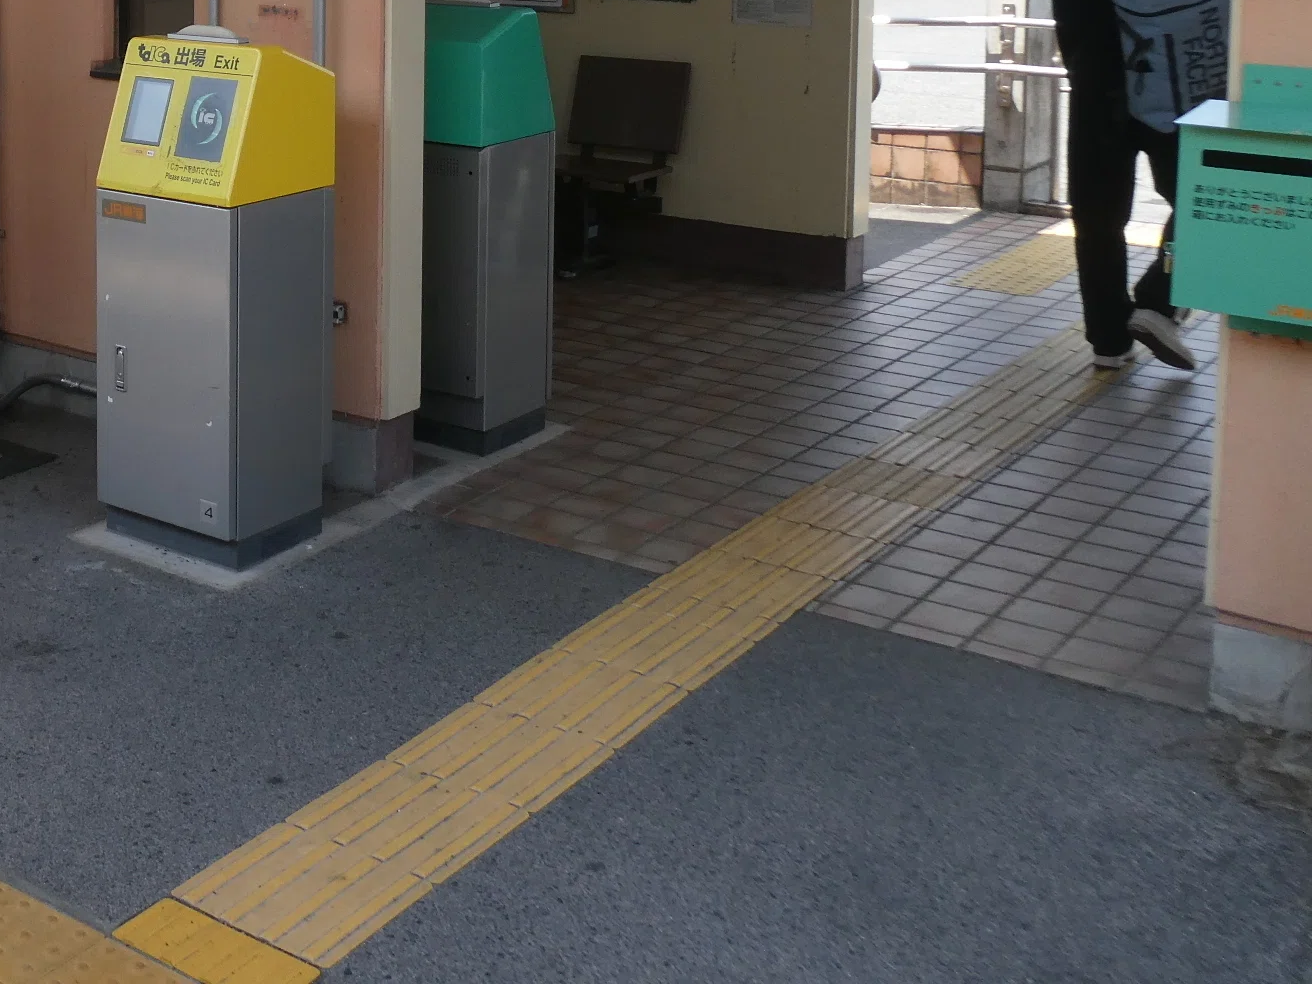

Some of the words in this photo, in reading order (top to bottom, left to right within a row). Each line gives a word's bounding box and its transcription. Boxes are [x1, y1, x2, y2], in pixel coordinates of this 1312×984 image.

[173, 47, 207, 67] 出場
[214, 55, 240, 71] Exit
[165, 172, 180, 181] Please
[209, 179, 220, 187] Card
[1194, 185, 1312, 206] ありがとうございまし
[204, 507, 213, 518] 4
